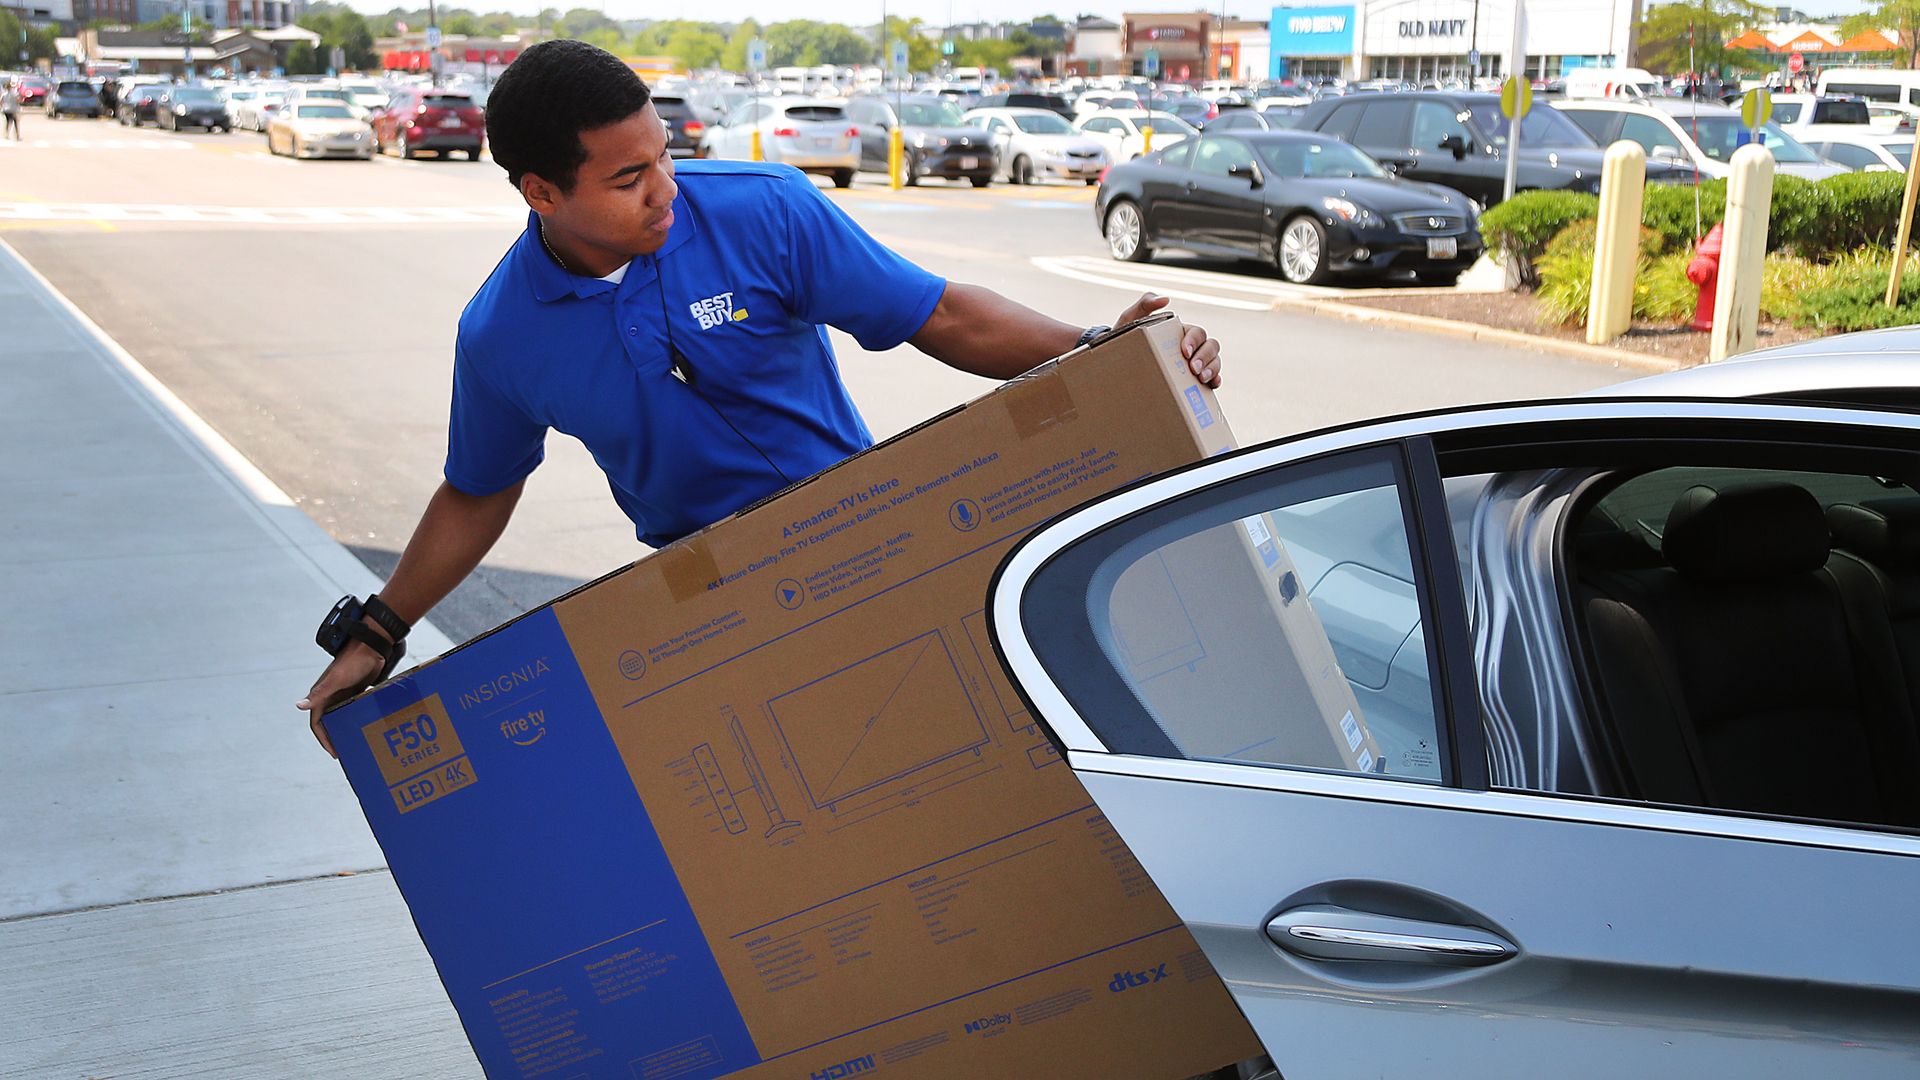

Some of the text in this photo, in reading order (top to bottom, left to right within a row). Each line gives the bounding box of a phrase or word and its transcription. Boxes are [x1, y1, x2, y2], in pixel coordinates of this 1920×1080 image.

[1312, 15, 1347, 33] BELOW
[1399, 19, 1466, 37] OLD NAVY
[689, 292, 733, 318] BEST
[698, 307, 733, 330] BUY
[980, 490, 1003, 503] Voice
[1002, 478, 1033, 494] Remote
[1033, 468, 1052, 480] with
[1052, 458, 1075, 472] Alexa
[1081, 448, 1097, 459] Just
[986, 501, 1007, 514] press
[1007, 493, 1023, 504] and
[1023, 487, 1037, 497] ask
[1046, 472, 1069, 486] easily
[1088, 450, 1118, 466] launch,
[783, 479, 899, 538] A Smarter TV Is Here
[991, 512, 1006, 523] and
[1005, 499, 1033, 516] control
[1033, 488, 1062, 503] movies
[1063, 478, 1078, 490] and
[707, 452, 999, 590] 4K Picture Quality, Fire TV Experience Built-in, Voice Remote with Alexa
[804, 568, 832, 583] Endless
[832, 545, 882, 571] Entertainment
[808, 581, 829, 592] Prime
[813, 590, 830, 601] HBO
[849, 575, 863, 586] and
[862, 567, 882, 580] more
[459, 659, 550, 711] INSIGNIA
[383, 713, 438, 758] F50
[500, 709, 545, 739] fire tv
[400, 743, 441, 768] SERIES
[398, 780, 435, 808] LED
[446, 761, 467, 783] 4K
[979, 1012, 1012, 1030] Dolby
[810, 1055, 876, 1080] HDMI
